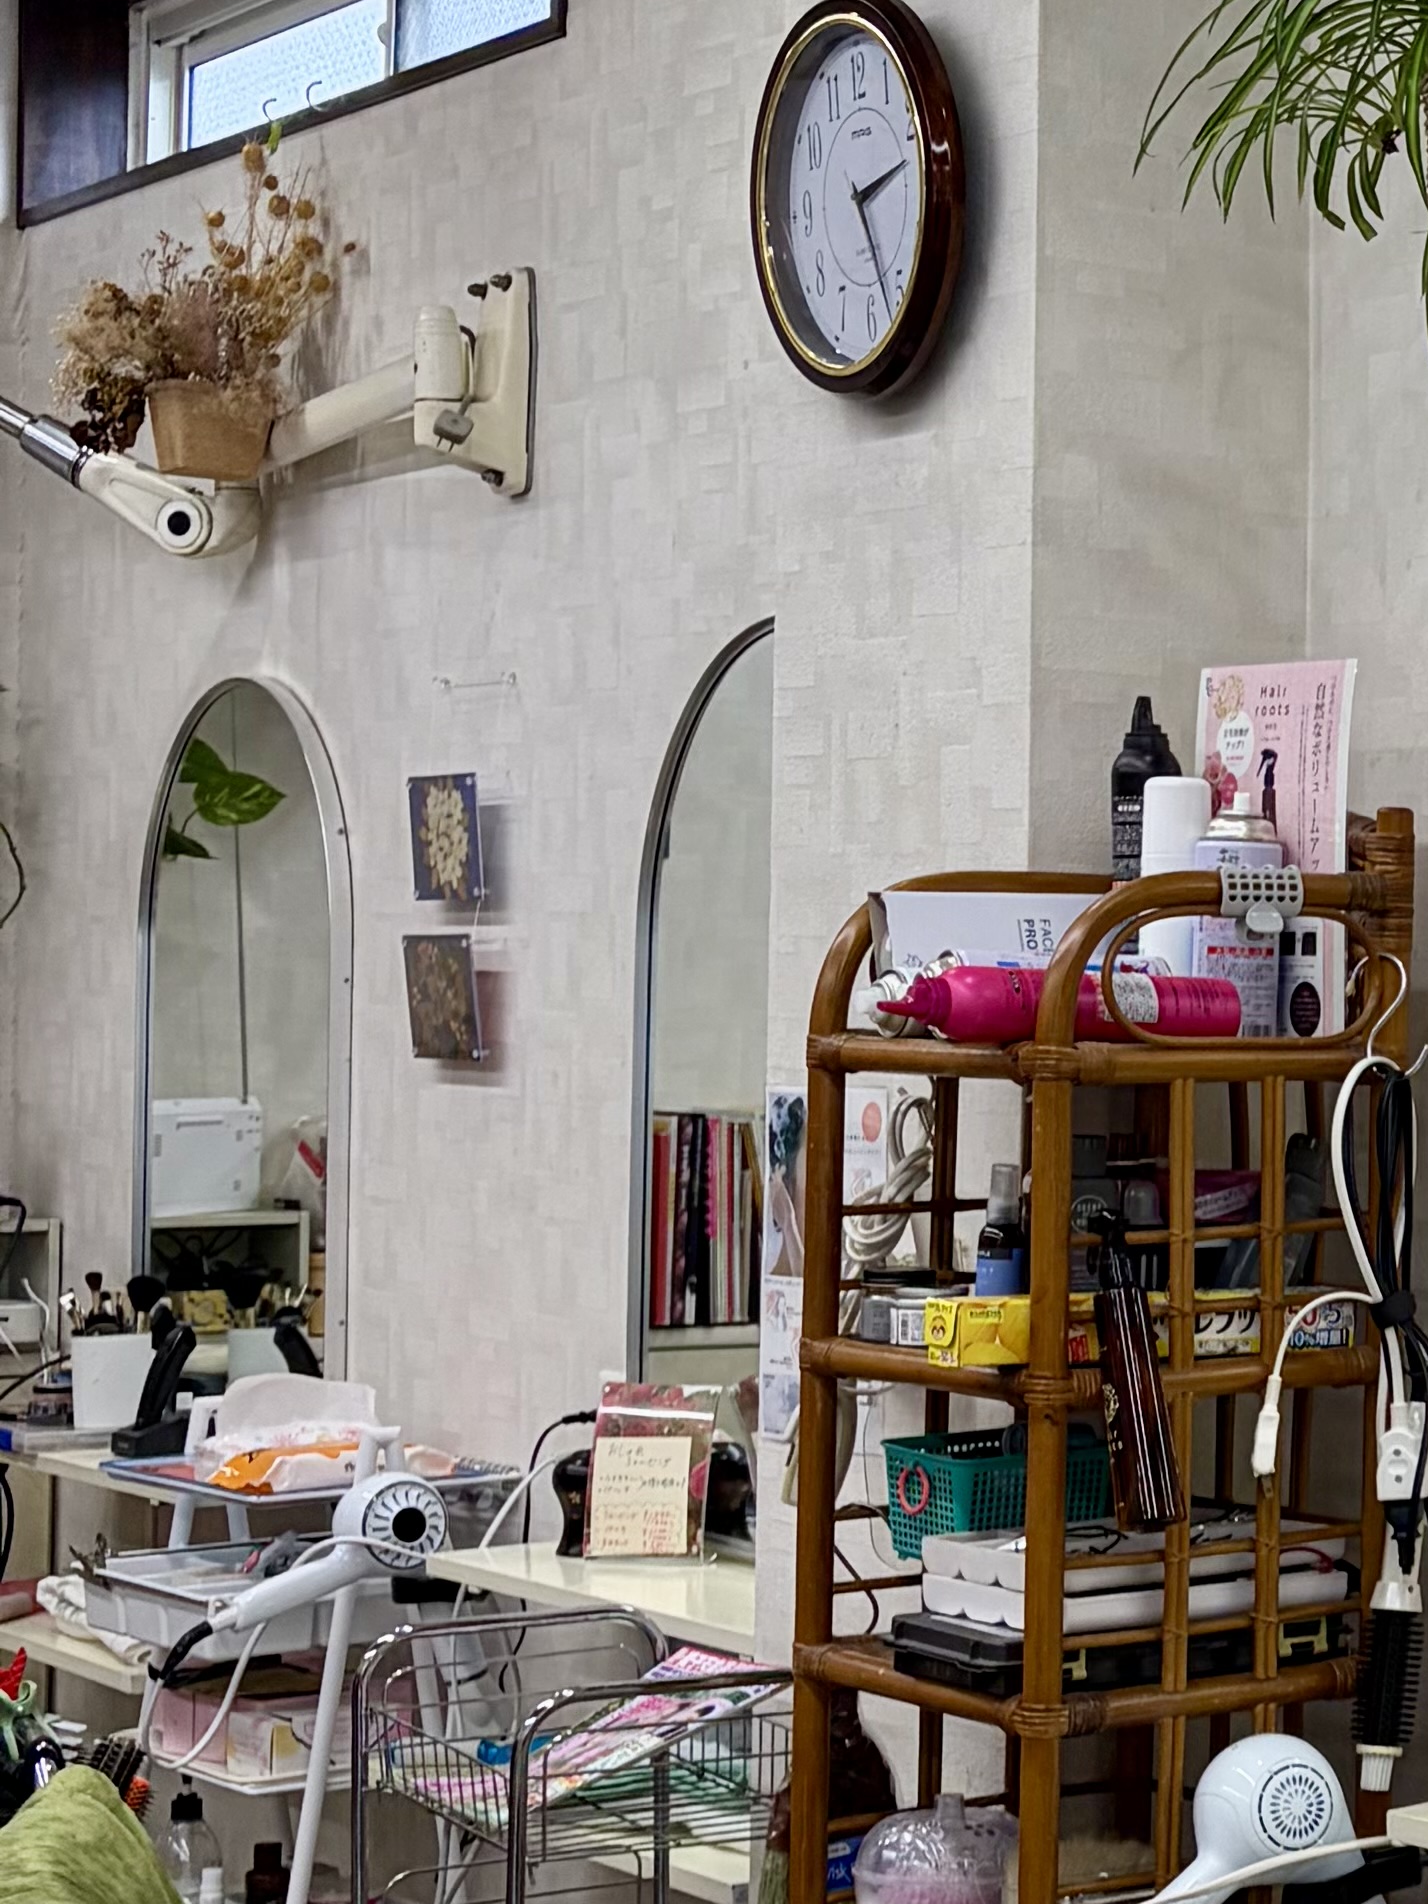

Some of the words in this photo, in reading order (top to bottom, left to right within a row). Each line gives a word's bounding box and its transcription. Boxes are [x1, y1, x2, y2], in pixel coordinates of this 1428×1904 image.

[826, 74, 840, 122] 11
[851, 51, 866, 102] 12
[883, 57, 889, 105] 1
[807, 121, 822, 171] 10
[803, 190, 813, 237] 9
[816, 249, 826, 297] 8
[838, 285, 846, 332] 7
[867, 294, 877, 342] 6
[1255, 704, 1290, 717] roots
[1260, 683, 1288, 699] Hair
[1023, 917, 1039, 951] PRO
